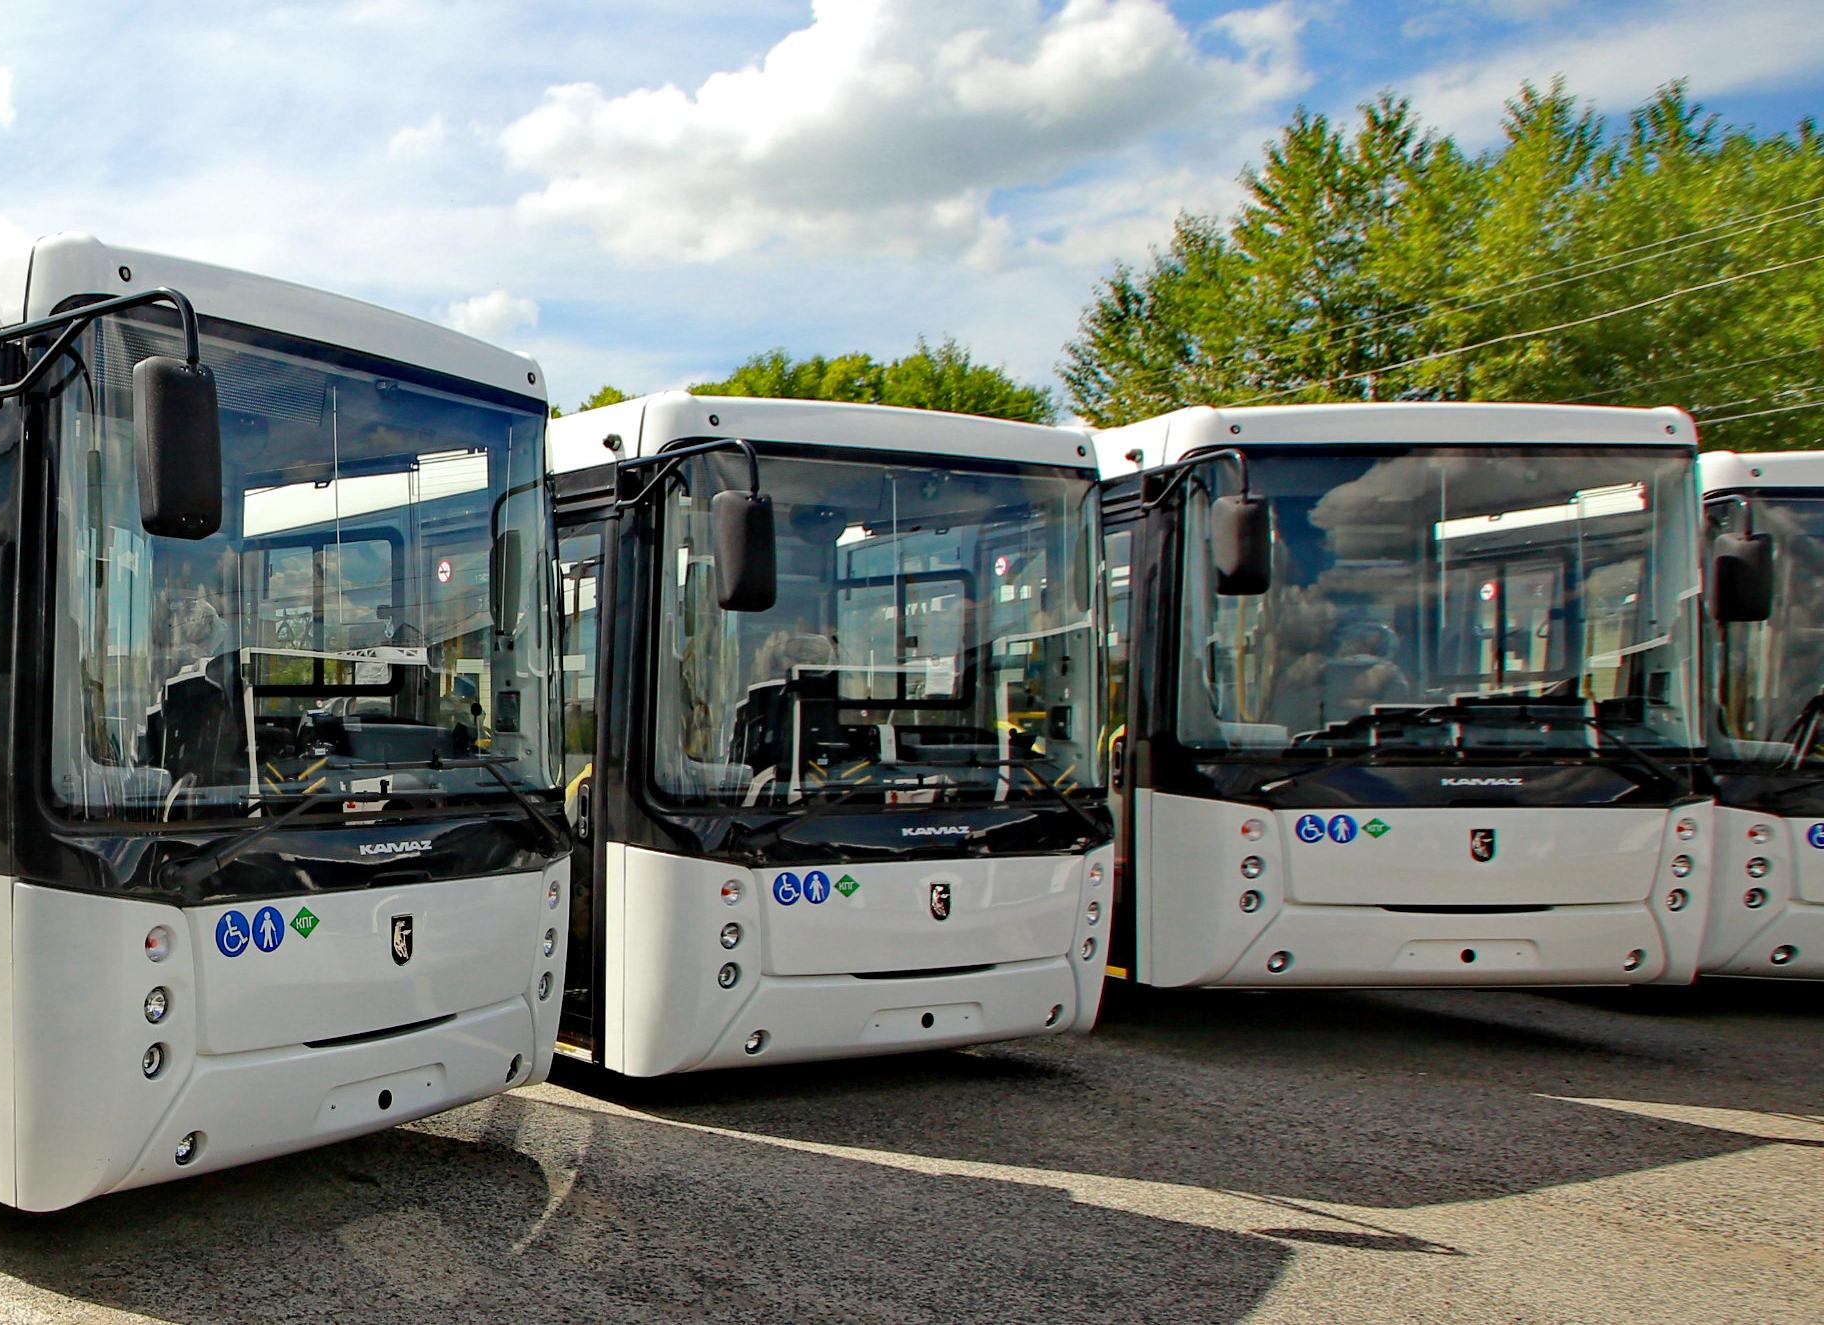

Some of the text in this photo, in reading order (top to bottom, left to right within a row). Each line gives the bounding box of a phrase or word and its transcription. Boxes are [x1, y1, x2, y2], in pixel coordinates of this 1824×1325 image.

[1440, 777, 1524, 786] KAMAZ
[901, 825, 971, 837] KAMAZ
[359, 839, 433, 856] KAMAZ
[838, 881, 857, 891] КПГ
[295, 915, 315, 930] КПГ
